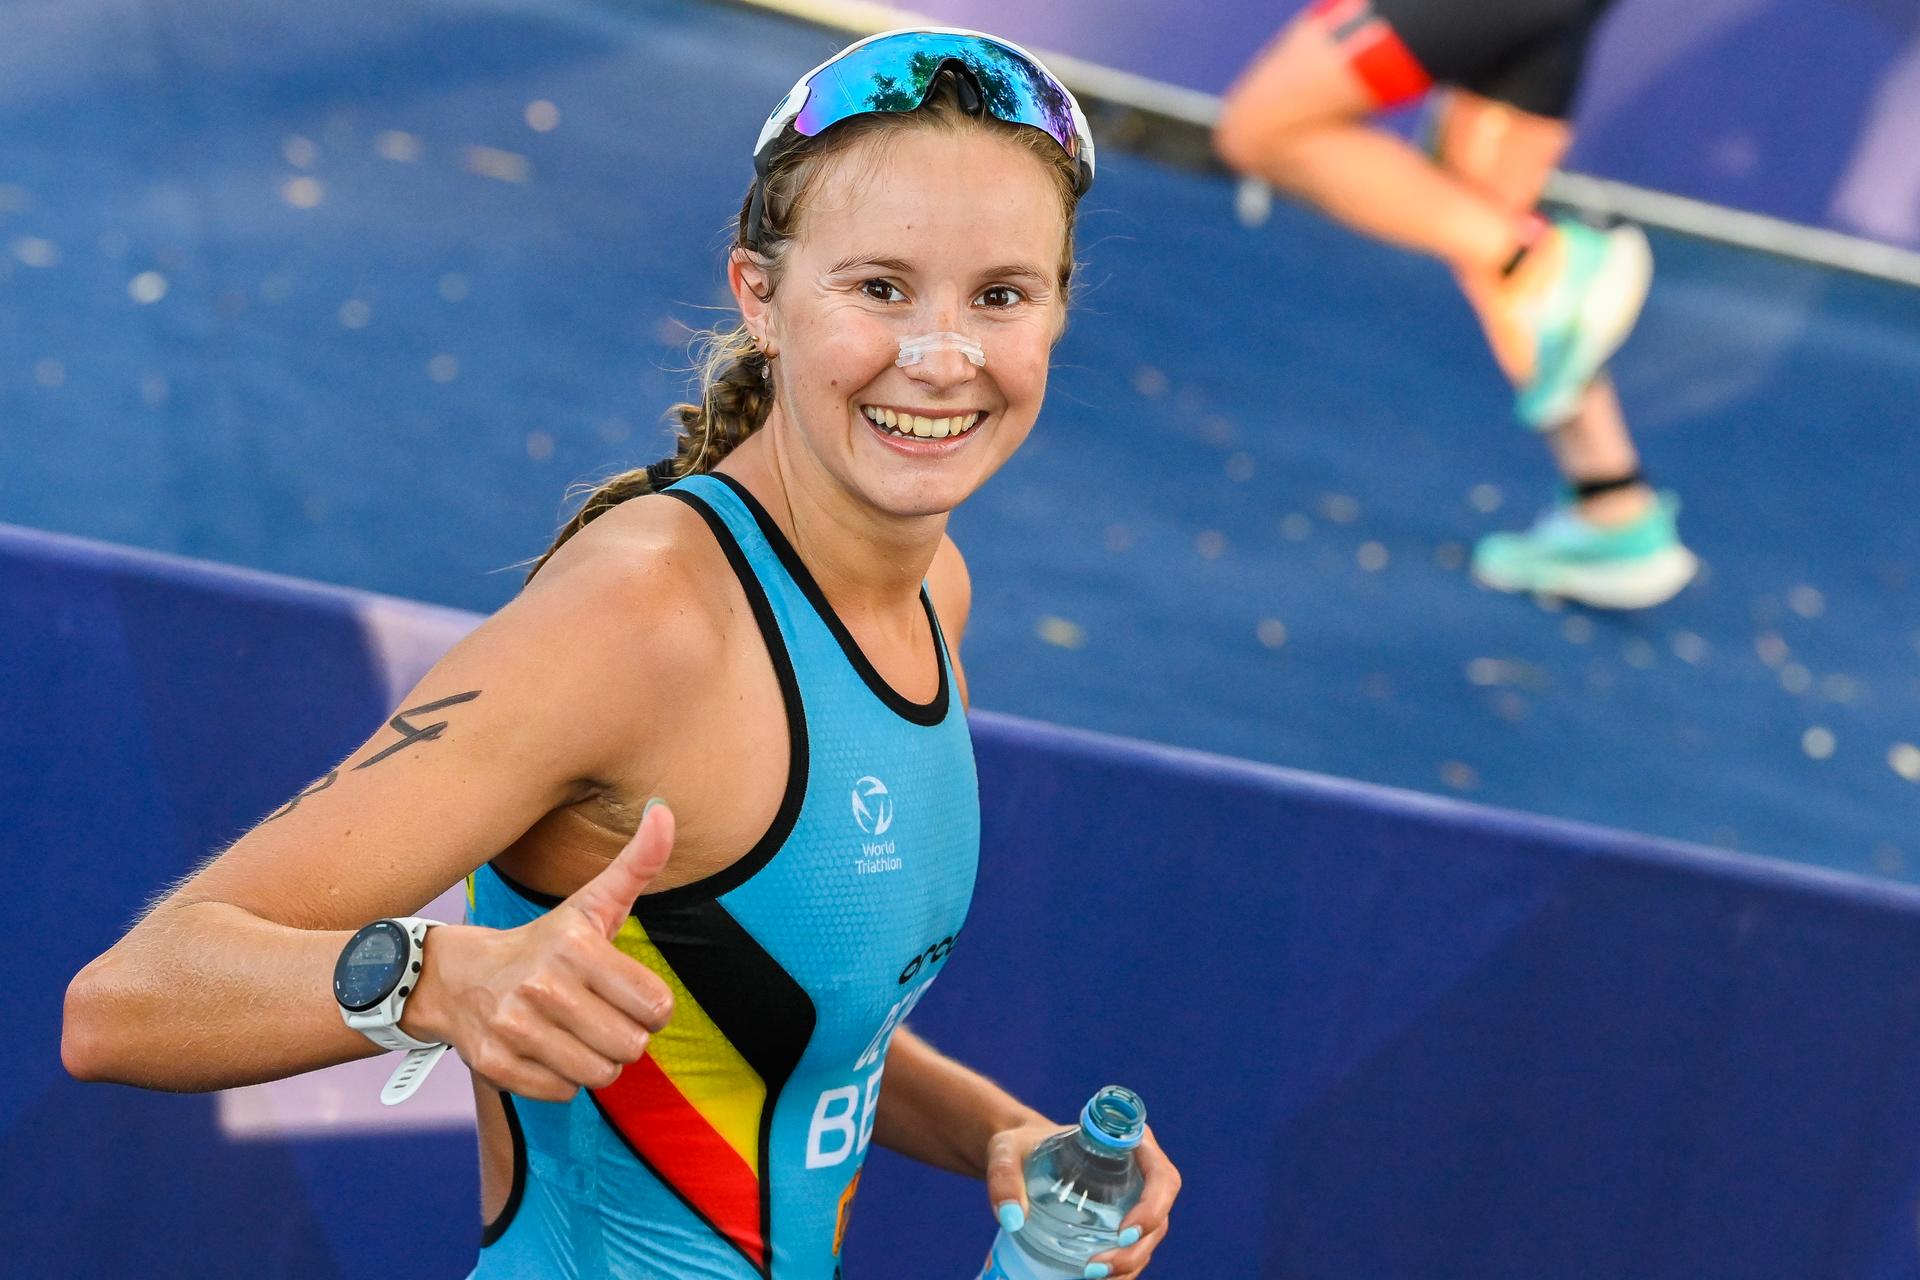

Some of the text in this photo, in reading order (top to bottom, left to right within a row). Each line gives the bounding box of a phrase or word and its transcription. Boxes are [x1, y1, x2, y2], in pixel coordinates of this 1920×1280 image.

[862, 840, 895, 857] World
[855, 857, 902, 875] Triathlon
[806, 1062, 885, 1169] BE
